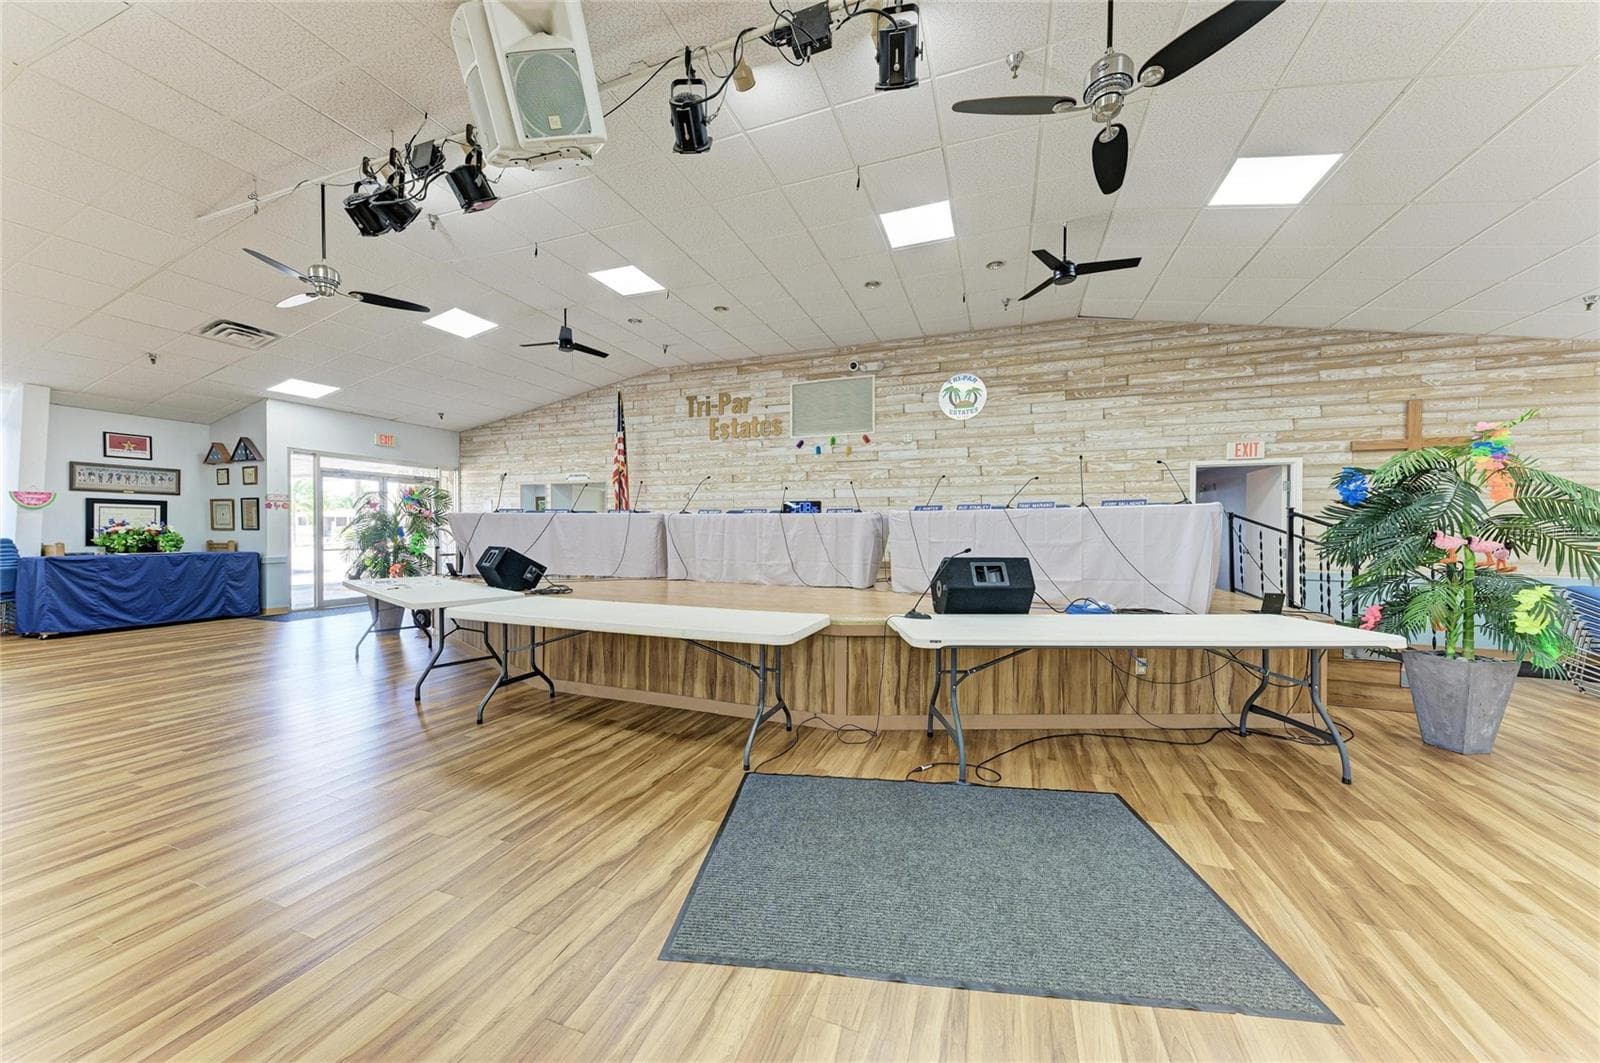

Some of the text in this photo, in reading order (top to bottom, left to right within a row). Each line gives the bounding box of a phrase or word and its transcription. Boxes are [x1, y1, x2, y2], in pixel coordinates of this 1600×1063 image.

[949, 375, 978, 384] TRI-PAR
[686, 392, 752, 418] Tri-Par
[950, 407, 978, 416] ESTATES
[709, 415, 782, 441] Estates
[379, 433, 394, 446] EXIT
[1235, 441, 1260, 458] EXIT
